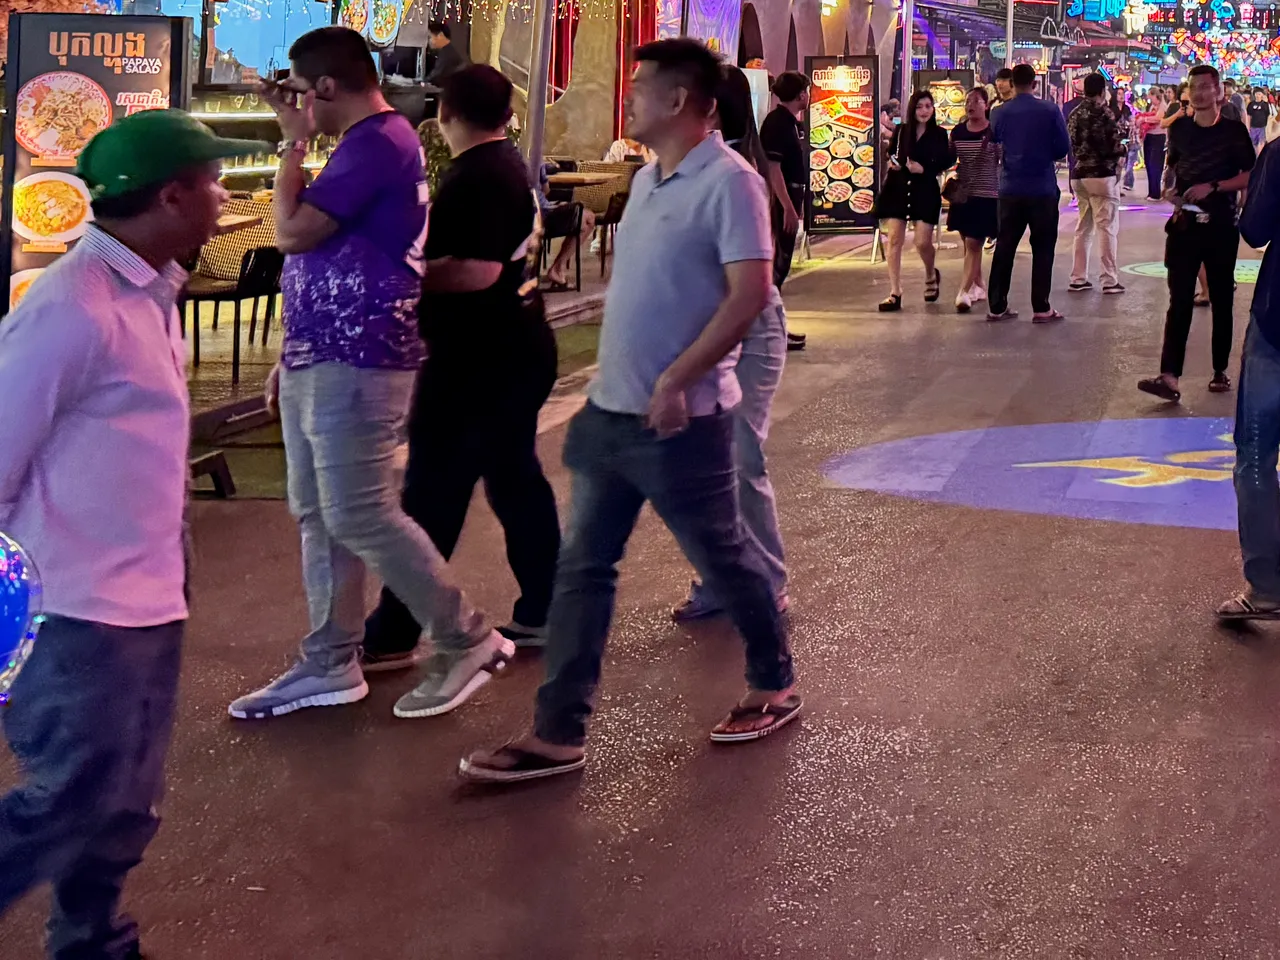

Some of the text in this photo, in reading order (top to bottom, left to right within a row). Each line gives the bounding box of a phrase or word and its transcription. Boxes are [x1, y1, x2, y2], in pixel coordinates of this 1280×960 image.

[121, 57, 162, 67] PAPAYA
[125, 65, 160, 74] SALAD
[847, 101, 863, 109] SET
